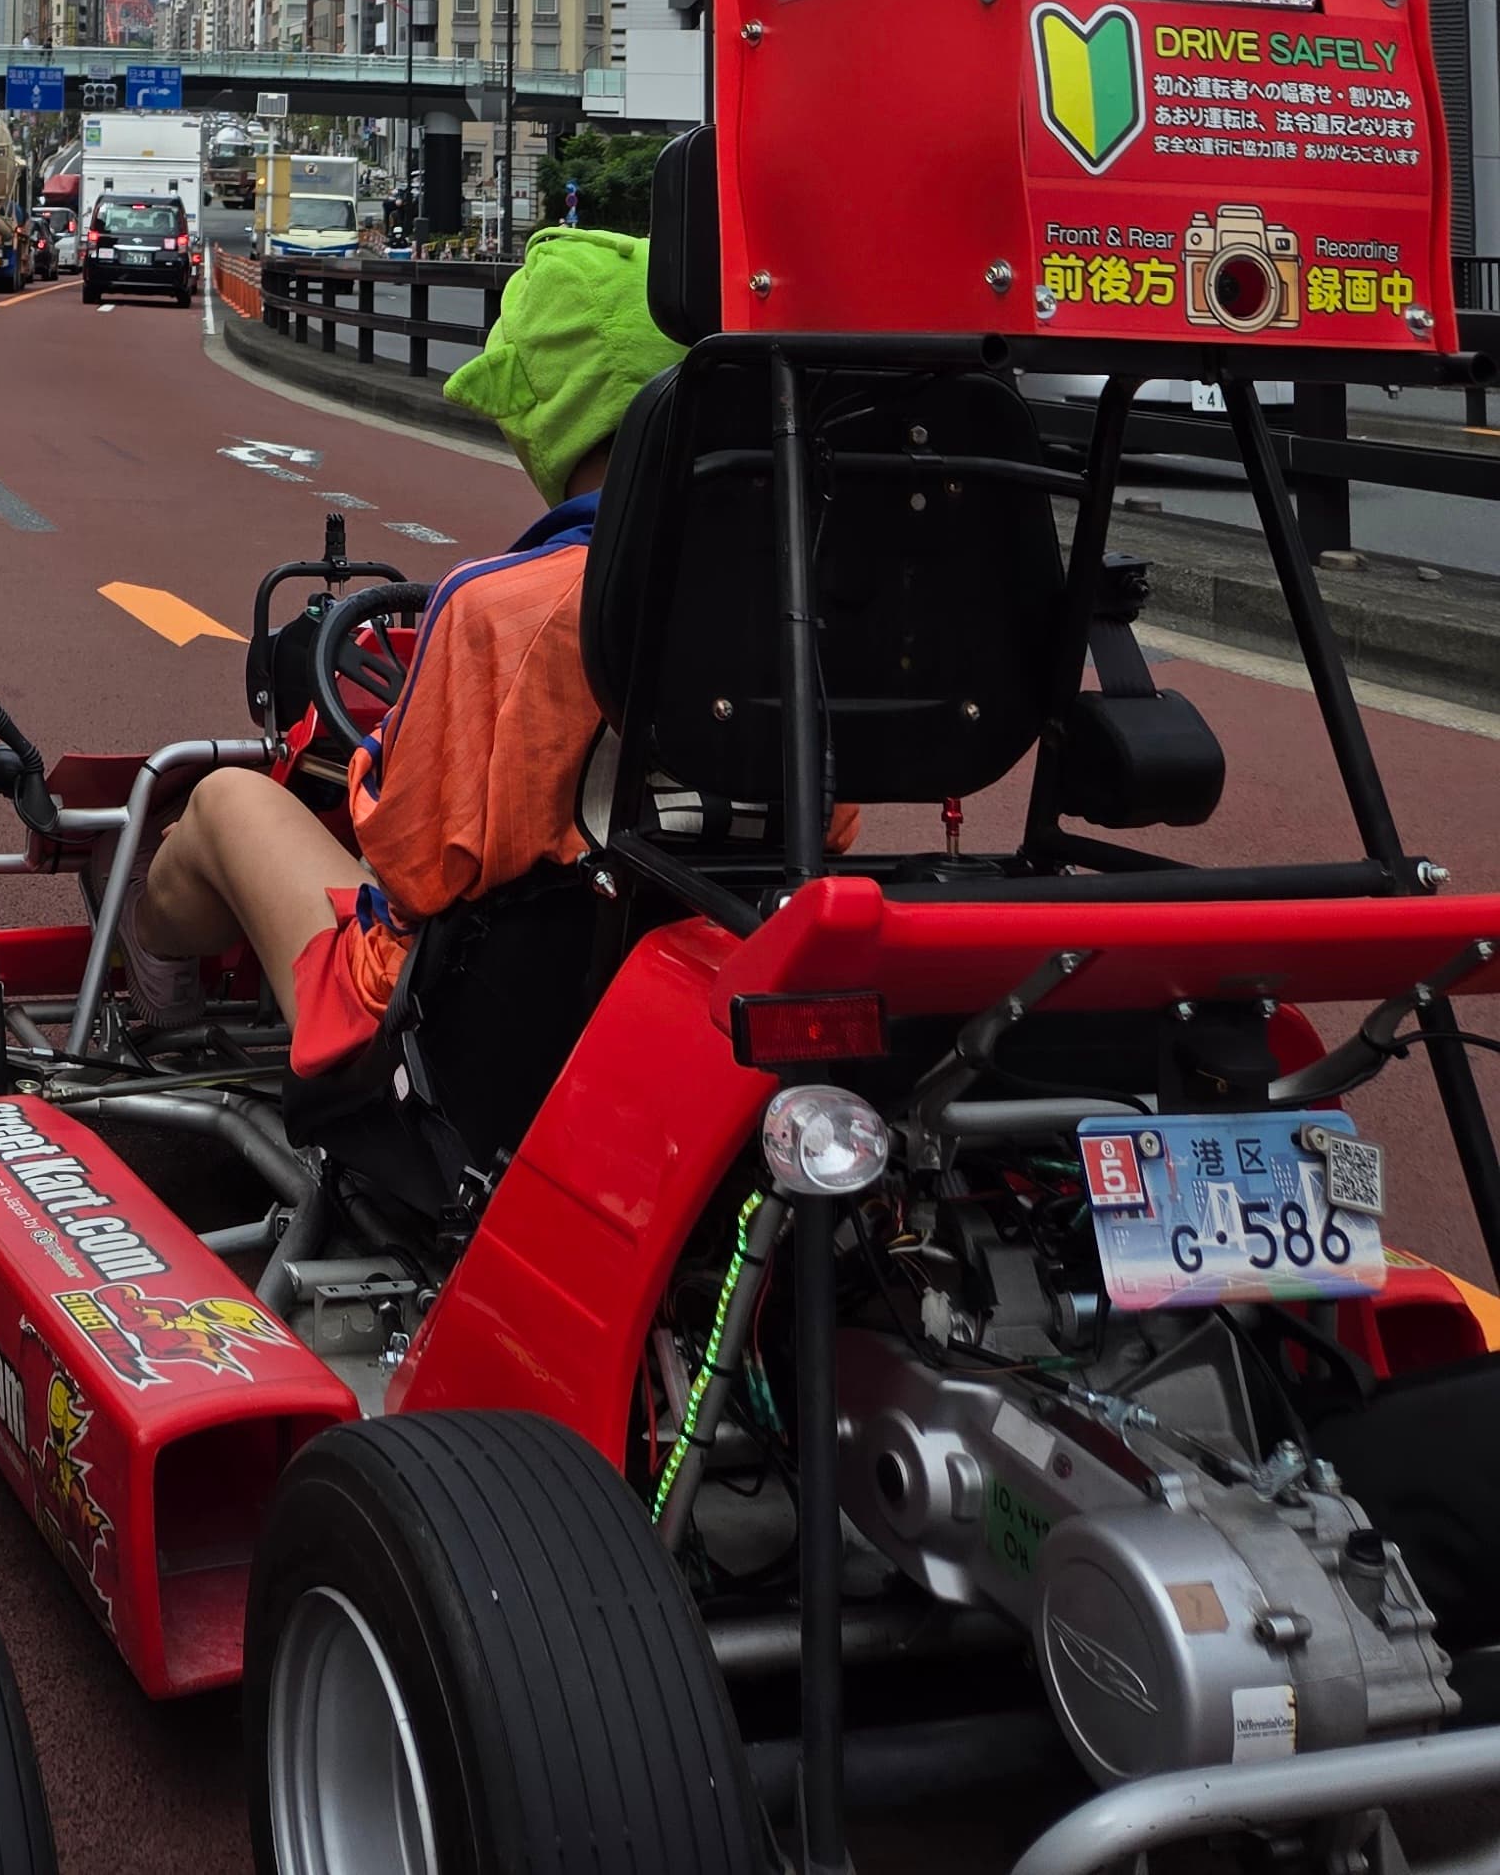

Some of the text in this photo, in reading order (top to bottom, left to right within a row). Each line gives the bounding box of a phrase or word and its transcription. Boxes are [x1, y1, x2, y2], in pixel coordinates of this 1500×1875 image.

[1155, 26, 1396, 72] DRIVE SAFELY
[1154, 75, 1411, 109] 初心運転者への幅寄せ・割り込み
[1154, 136, 1419, 165] 安全な運行に協力頂き ありがとうございます
[1046, 224, 1175, 249] Front & Rear
[1316, 238, 1398, 261] Recording
[1042, 252, 1177, 305] 前後方
[1306, 266, 1413, 315] 録画中
[5, 1194, 29, 1219] Japan
[25, 1217, 39, 1228] by
[60, 1293, 114, 1331] STREET
